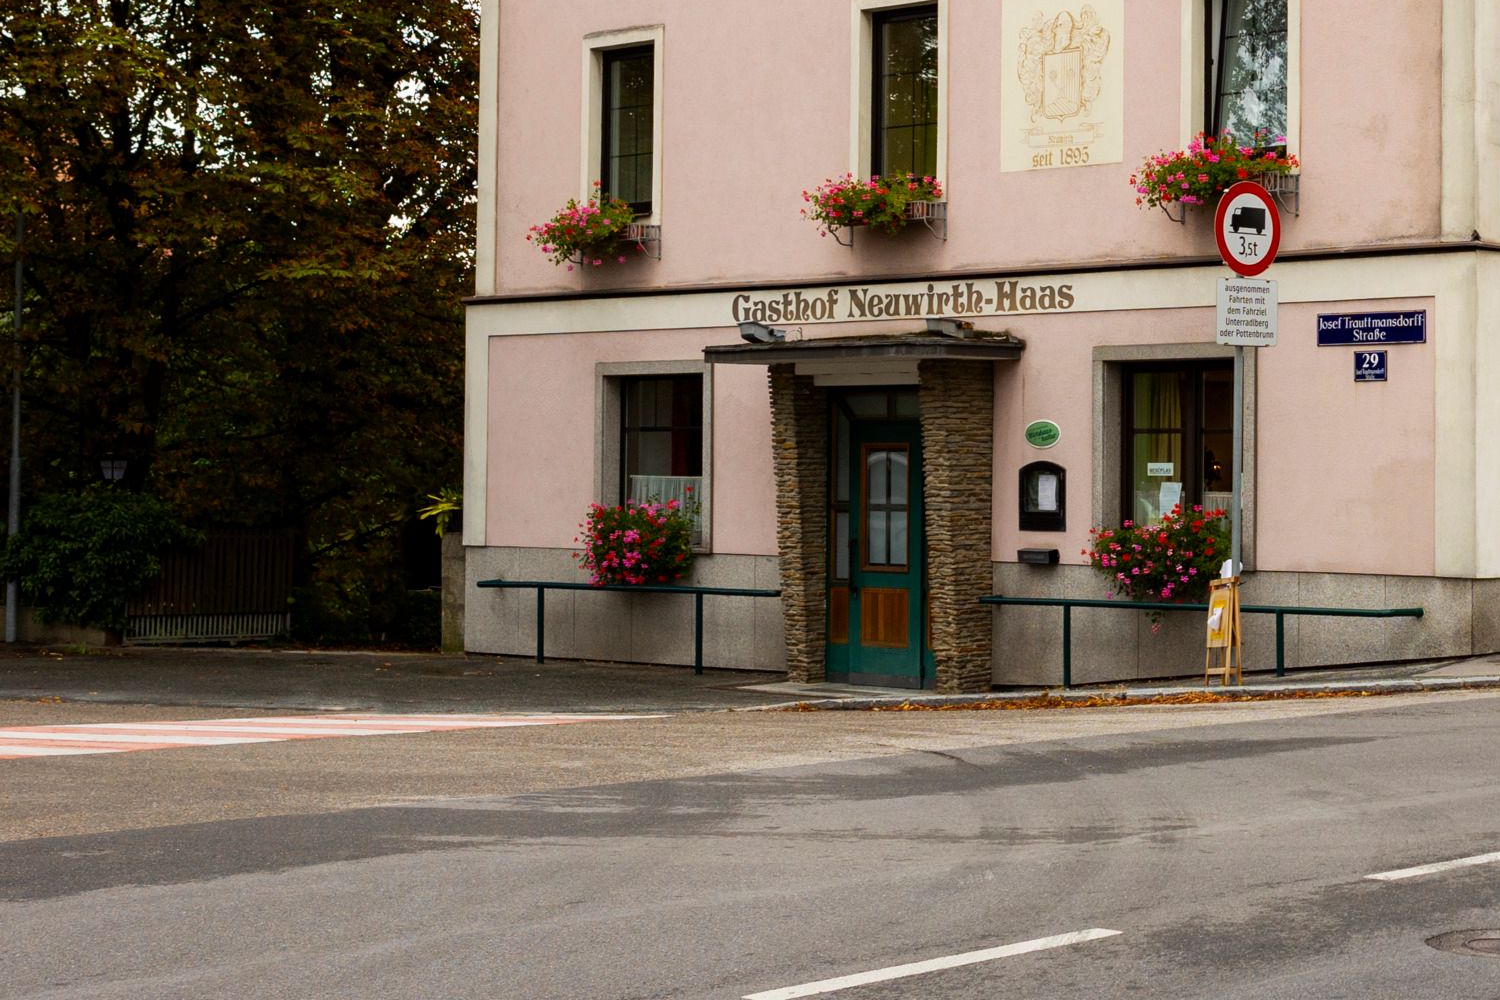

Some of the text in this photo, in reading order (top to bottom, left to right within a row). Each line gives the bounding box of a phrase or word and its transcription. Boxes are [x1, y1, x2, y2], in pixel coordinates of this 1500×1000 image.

[1032, 146, 1089, 167] seit 1895
[1225, 284, 1270, 294] ausgenommen
[732, 280, 1075, 323] Gasthof Neuwirth-Haas
[1229, 294, 1265, 305] Fahrten mit
[1227, 306, 1267, 316] dem Fahrziel
[1225, 317, 1269, 329] Unterradlberg
[1319, 317, 1342, 331] Josef
[1236, 329, 1274, 338] Pottenbrunn
[1352, 328, 1386, 342] Straße
[1362, 353, 1379, 368] 29
